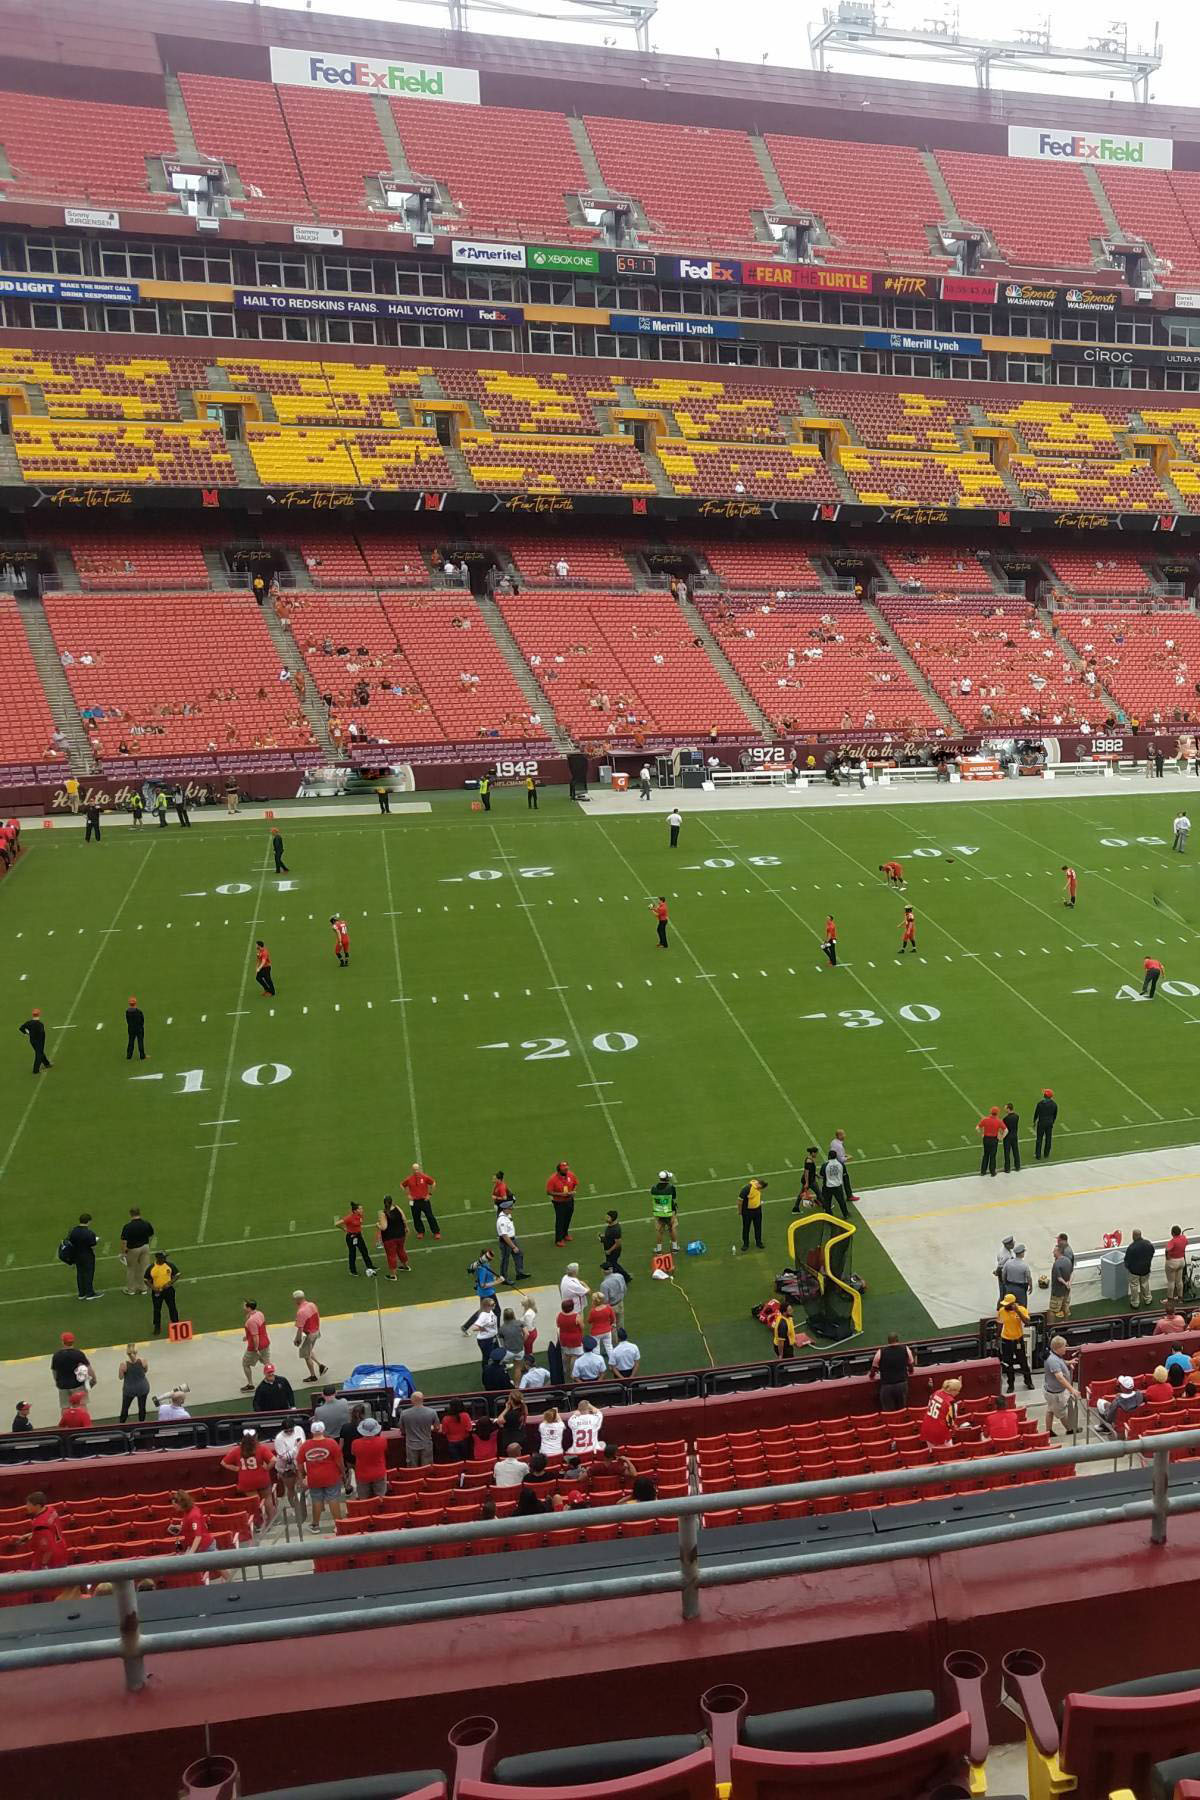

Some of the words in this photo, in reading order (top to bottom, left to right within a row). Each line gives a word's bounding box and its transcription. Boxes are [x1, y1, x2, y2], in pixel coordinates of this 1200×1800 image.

[309, 57, 444, 96] FedExField
[1039, 133, 1144, 163] FedExField
[467, 246, 522, 262] Ameritel
[547, 254, 573, 265] XBOX
[573, 255, 593, 266] ONE
[679, 259, 735, 281] FedEx
[15, 282, 54, 293] LIGHT
[1021, 287, 1057, 300] Sports
[1007, 297, 1055, 308] WASHINGTON
[1081, 290, 1118, 303] Sports
[243, 295, 269, 306] HAIL
[270, 297, 286, 308] TO
[288, 299, 345, 311] REDSKINS
[347, 302, 379, 313] FANS.
[388, 304, 414, 315] HAIL
[414, 306, 464, 318] VICTORY!
[1067, 301, 1115, 311] WASHINGTON
[479, 310, 507, 320] FedEx
[652, 320, 684, 333] Merrill
[686, 322, 714, 335] Lynch
[902, 338, 932, 350] Merrill
[933, 340, 959, 351] Lynch
[1166, 355, 1192, 363] ULTRA
[1091, 739, 1124, 752] 1982
[748, 748, 784, 762] 1972
[495, 761, 538, 777] 1942
[838, 1003, 941, 1028] 30
[521, 1031, 639, 1061] 20
[173, 1062, 292, 1093] 10
[656, 1256, 672, 1272] 20
[173, 1322, 191, 1341] 10
[575, 1428, 593, 1448] 21
